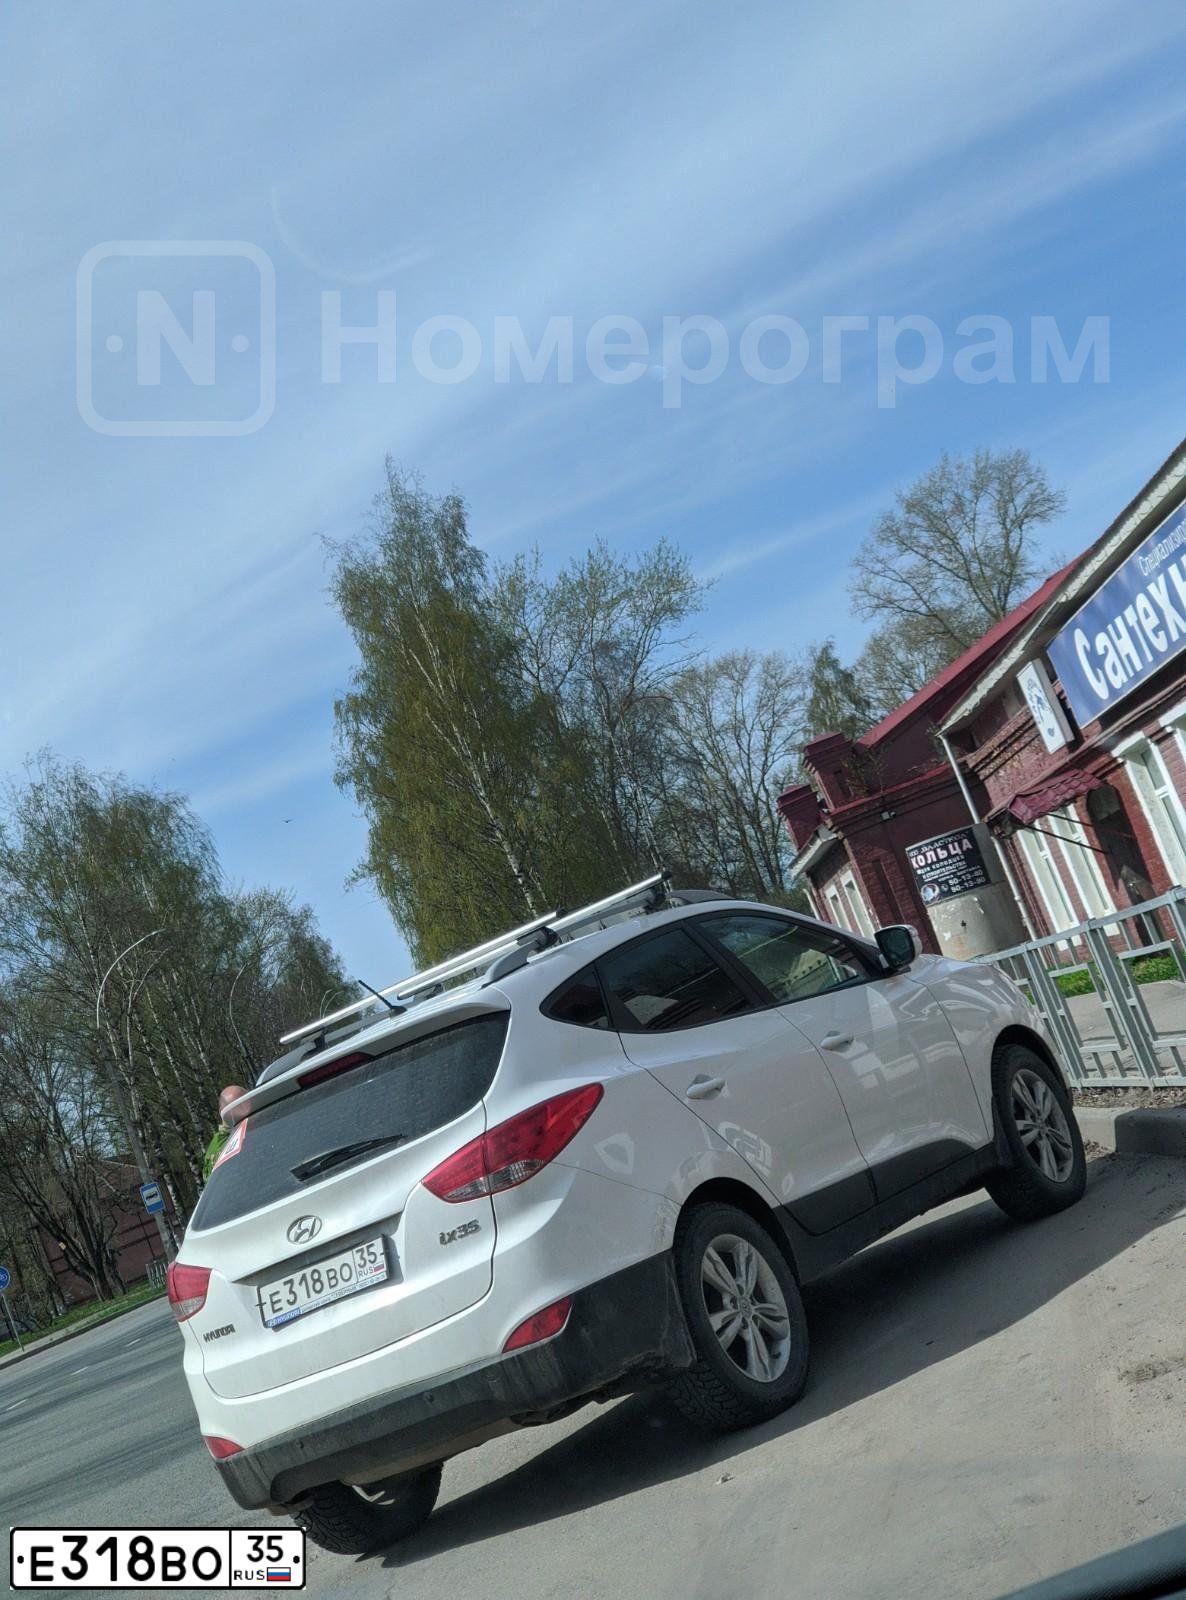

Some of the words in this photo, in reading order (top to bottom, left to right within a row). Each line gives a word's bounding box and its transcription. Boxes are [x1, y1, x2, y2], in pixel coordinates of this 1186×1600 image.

[910, 838, 974, 869] КОЛЬЦА
[439, 1219, 482, 1245] ix35
[355, 1243, 378, 1269] 35
[358, 1266, 375, 1279] RUS
[202, 1323, 236, 1343] HYUNDAI
